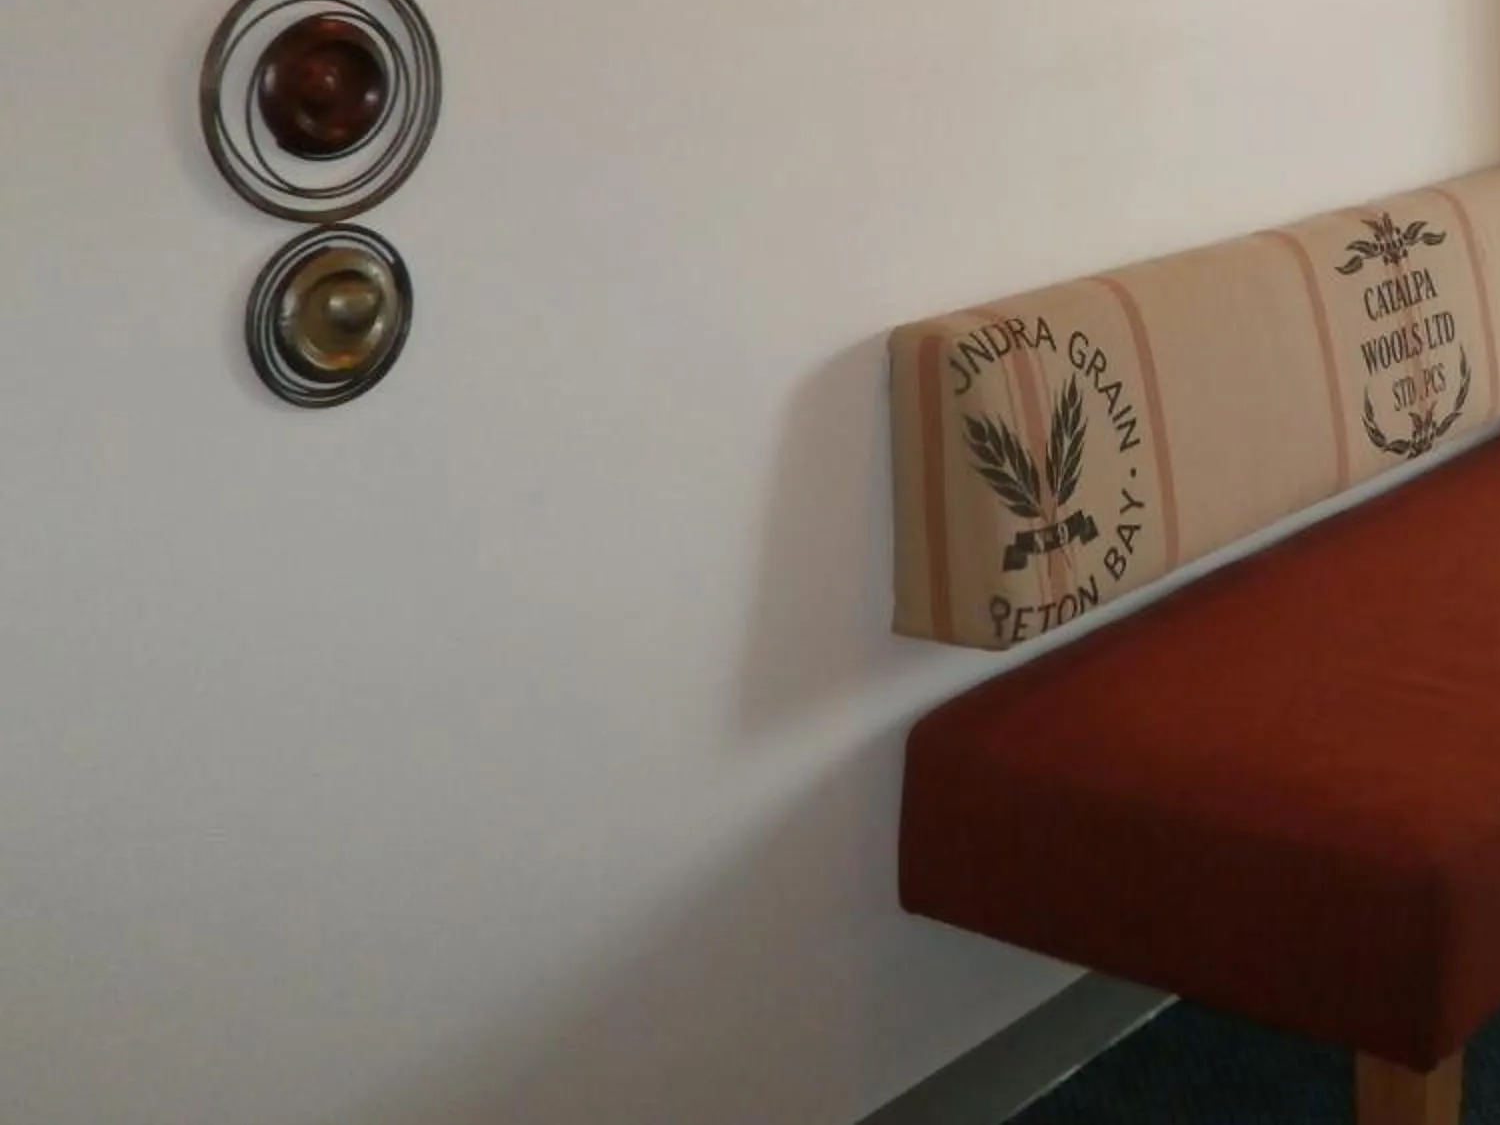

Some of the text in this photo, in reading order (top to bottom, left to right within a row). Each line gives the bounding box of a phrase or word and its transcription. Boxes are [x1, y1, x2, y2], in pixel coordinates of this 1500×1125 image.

[1363, 267, 1437, 322] CATALPA
[1360, 311, 1455, 376] WOOLS LTD
[1068, 330, 1141, 452] GRAIN
[990, 574, 1099, 644] PETON
[1103, 487, 1145, 582] BAY
